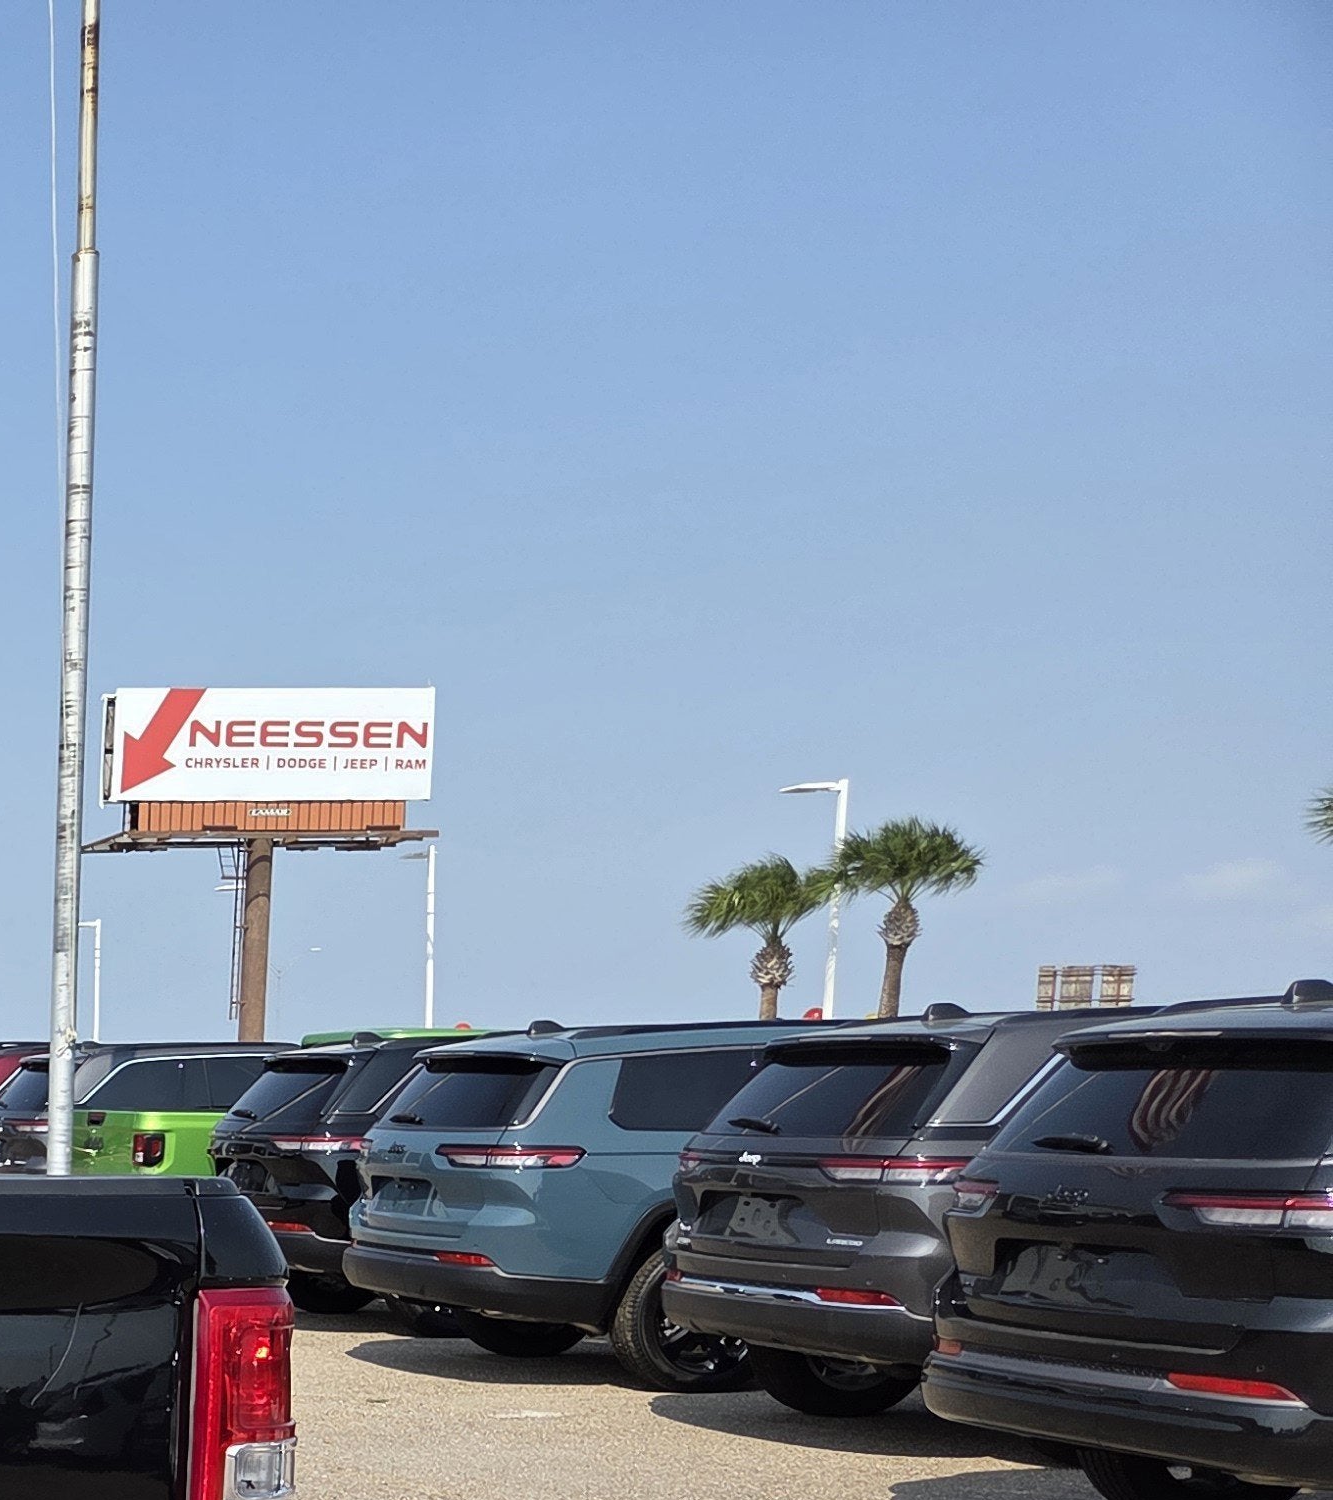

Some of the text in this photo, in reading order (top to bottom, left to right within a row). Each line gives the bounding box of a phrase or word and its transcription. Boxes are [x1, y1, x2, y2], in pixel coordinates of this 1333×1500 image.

[189, 720, 428, 748] NEESSEN
[185, 757, 427, 770] CHRYSLER DODGE JEEP RAM
